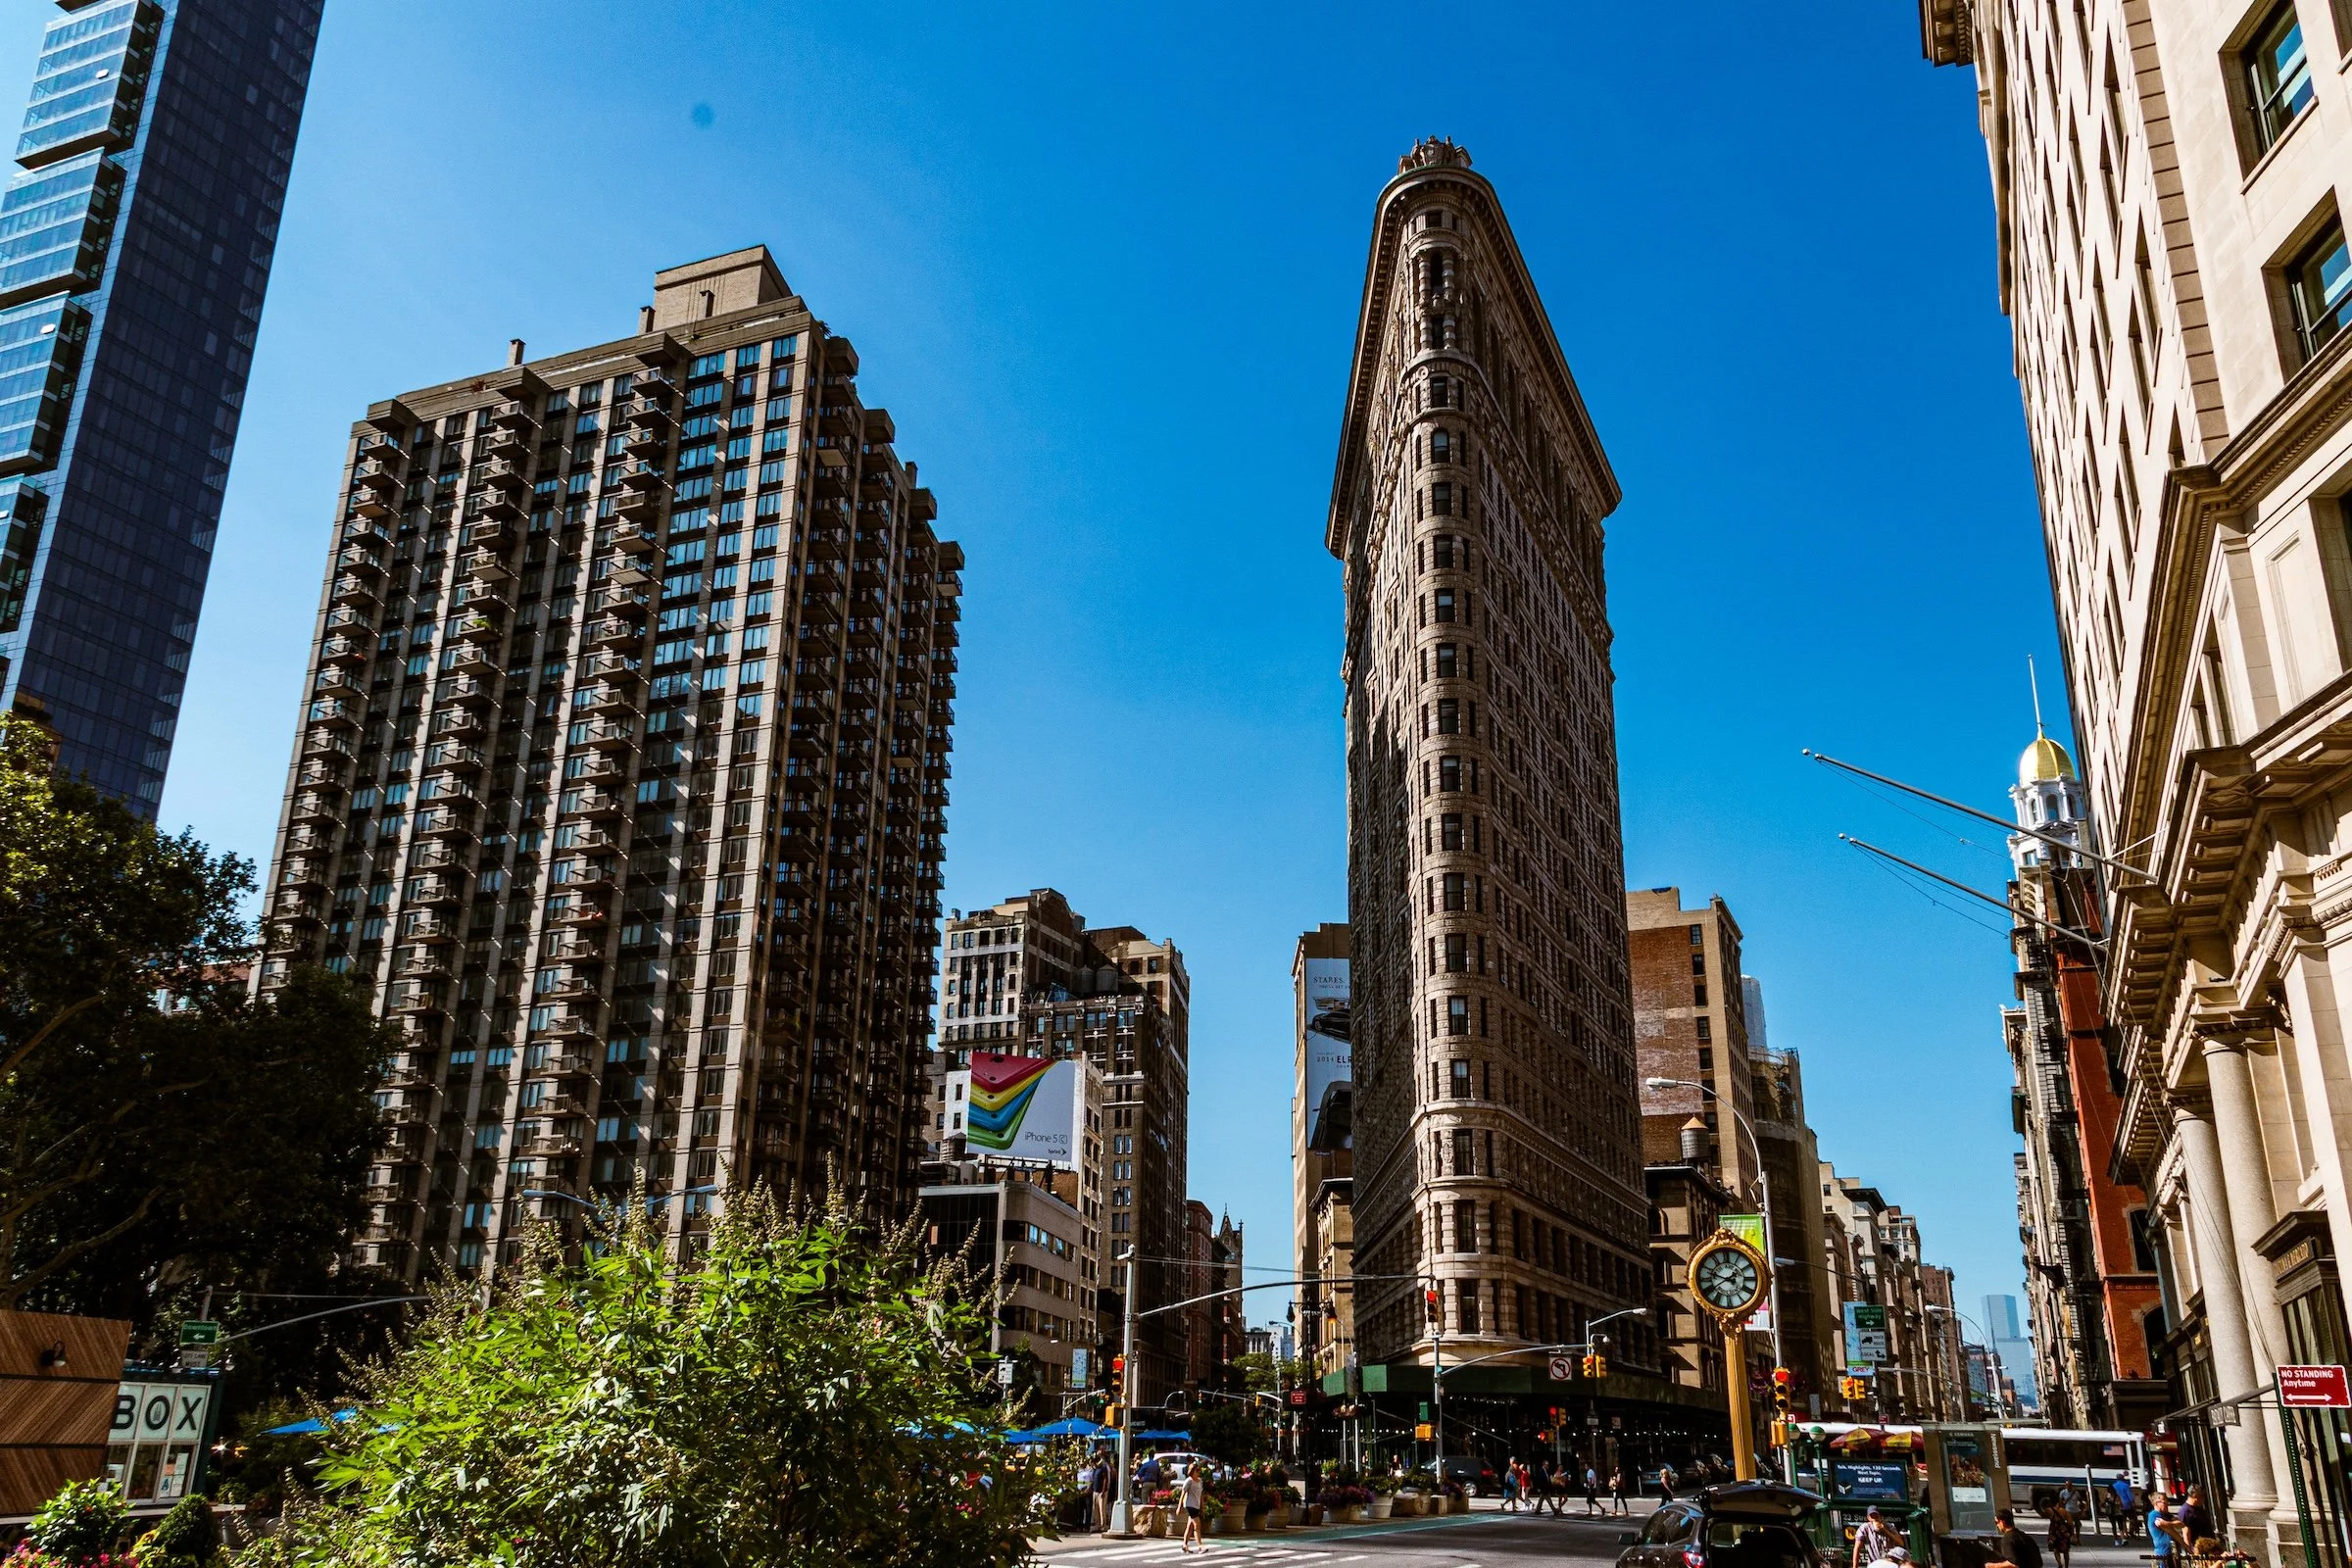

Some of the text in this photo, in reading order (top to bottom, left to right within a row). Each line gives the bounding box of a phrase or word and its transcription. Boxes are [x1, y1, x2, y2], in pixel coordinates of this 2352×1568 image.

[1025, 1131, 1052, 1143] iPhone
[2294, 1370, 2333, 1379] STANDING
[2283, 1379, 2316, 1388] Anytime
[111, 1395, 203, 1431] BOX
[1990, 1433, 2001, 1469] Newsstand
